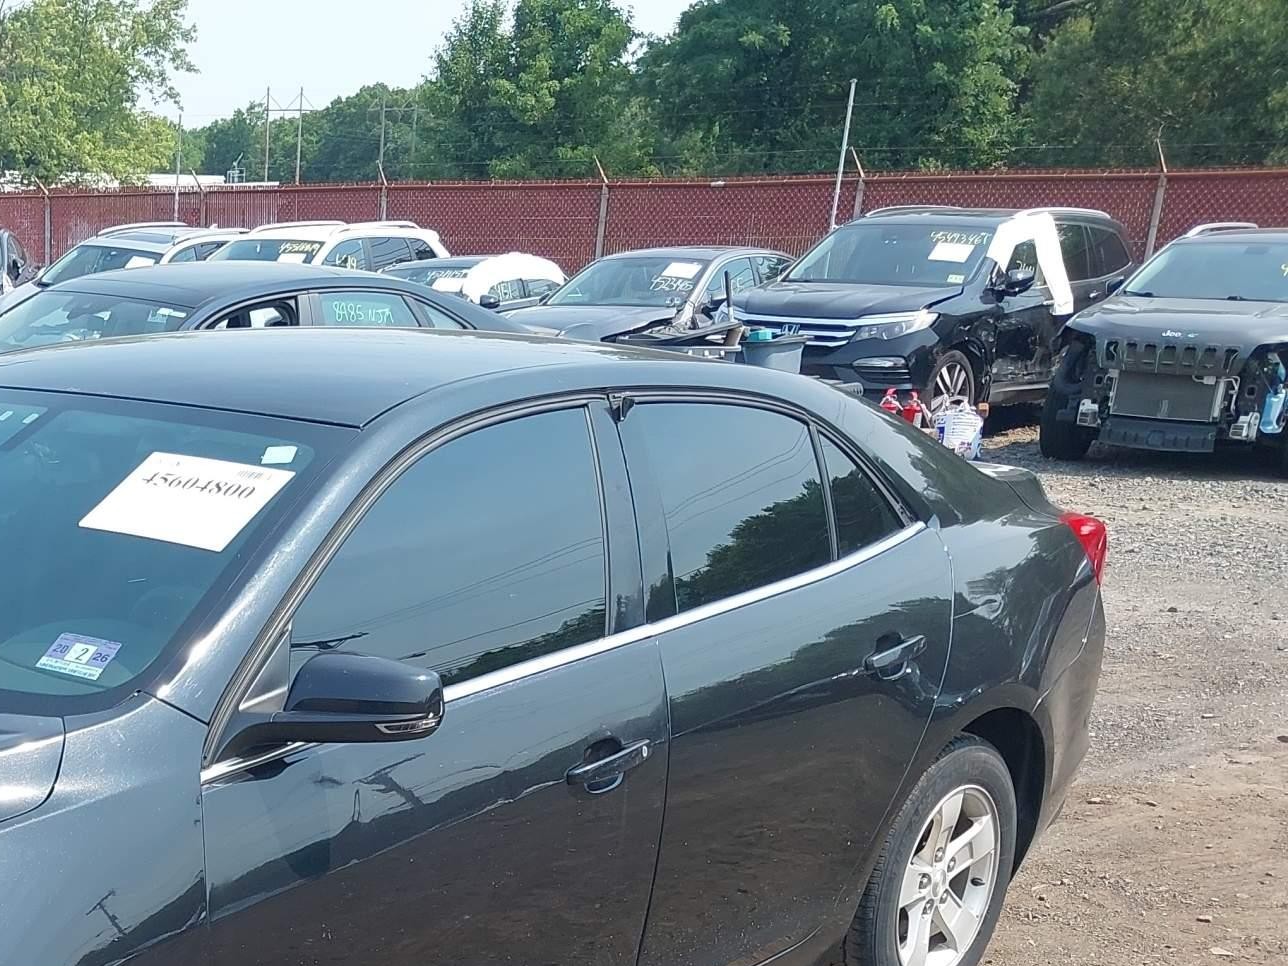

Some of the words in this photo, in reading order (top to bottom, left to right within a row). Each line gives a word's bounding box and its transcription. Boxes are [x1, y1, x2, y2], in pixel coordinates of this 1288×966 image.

[142, 471, 257, 500] 45604800
[52, 643, 70, 654] 20
[75, 647, 90, 661] 2
[92, 652, 111, 663] 26
